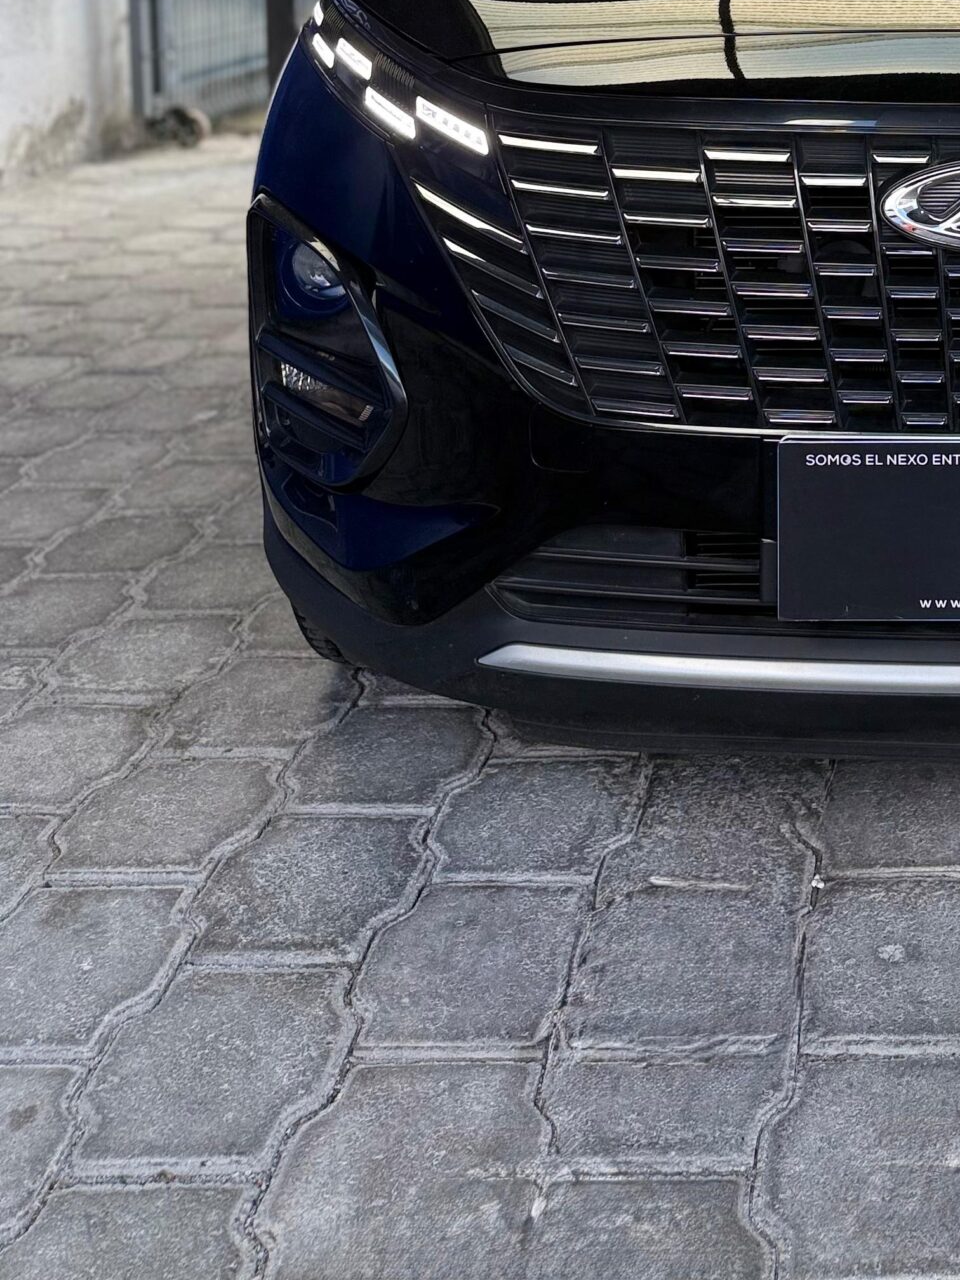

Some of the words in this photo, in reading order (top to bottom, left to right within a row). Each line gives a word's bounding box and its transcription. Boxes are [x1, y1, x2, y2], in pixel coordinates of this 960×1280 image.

[805, 454, 862, 466] SOMOS
[865, 454, 883, 465] EL
[886, 454, 928, 466] NEXO
